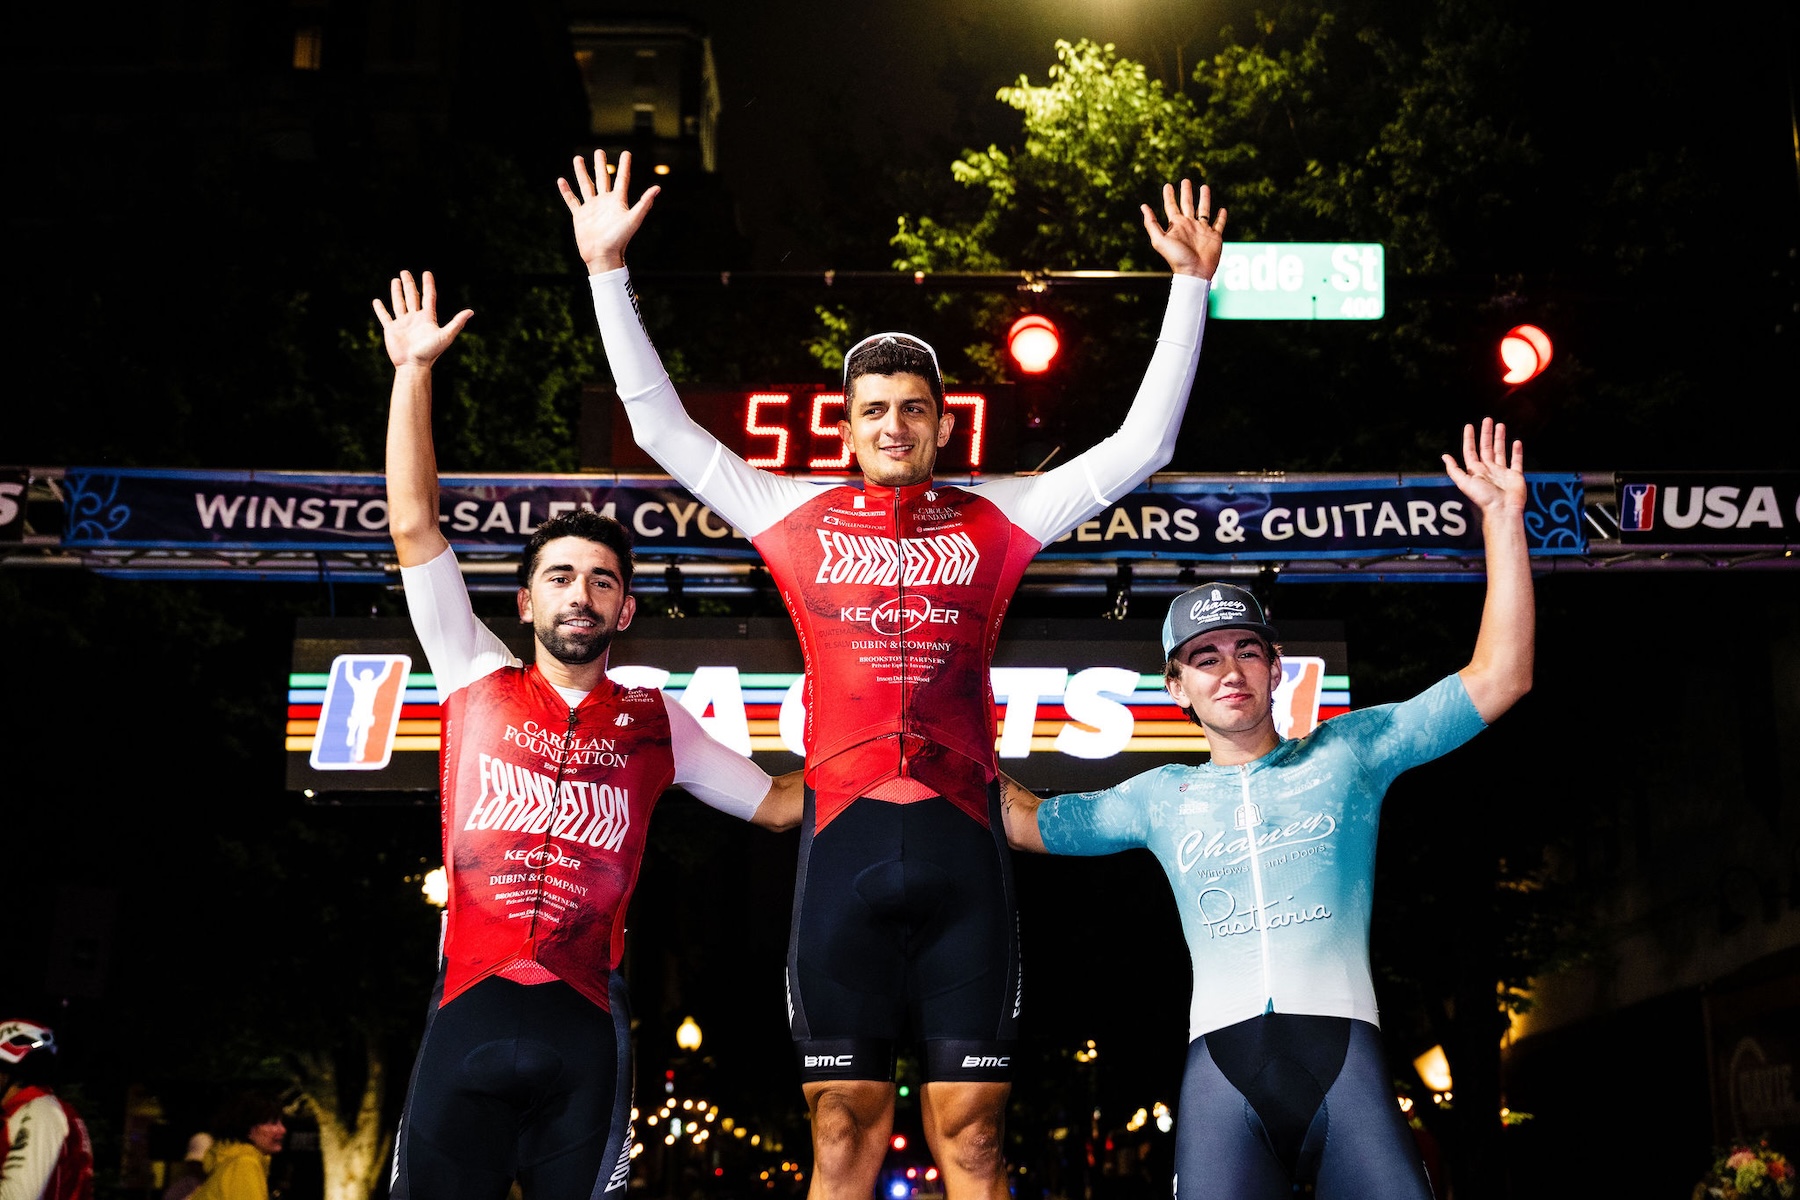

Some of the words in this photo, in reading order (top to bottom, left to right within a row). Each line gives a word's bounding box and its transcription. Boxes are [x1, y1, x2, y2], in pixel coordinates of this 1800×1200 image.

[1210, 245, 1304, 291] rade
[1331, 244, 1378, 292] St
[1340, 296, 1380, 318] 400
[195, 493, 617, 537] WINSTO-SALE
[633, 501, 756, 539] CYC
[1056, 507, 1201, 543] EARS
[1214, 508, 1246, 543] &
[1261, 500, 1467, 541] GUITARS
[912, 511, 963, 520] FOUNDATION
[1662, 486, 1784, 529] USA
[815, 529, 980, 563] FOUNDATION
[840, 606, 959, 625] KEMPNER
[1189, 598, 1247, 620] Chaney
[851, 640, 887, 650] DUBIN
[889, 640, 898, 649] &
[899, 640, 951, 652] COMPANY
[909, 656, 945, 664] PARTNERS
[502, 724, 628, 769] FOUNDATION
[522, 720, 616, 752] CAROLAN
[479, 752, 630, 826] FOUNDATION
[1177, 811, 1337, 874] Chaney
[504, 849, 581, 871] KEMPNER
[1197, 863, 1250, 880] Windows
[1264, 853, 1288, 869] and
[1290, 843, 1327, 861] Doors
[489, 873, 527, 886] DUBIN
[528, 872, 538, 882] &
[538, 873, 588, 897] COMPANY
[543, 890, 579, 909] PARTNERS
[1197, 886, 1333, 939] Pastaria
[804, 1054, 854, 1068] BMC
[961, 1055, 1011, 1068] BMC
